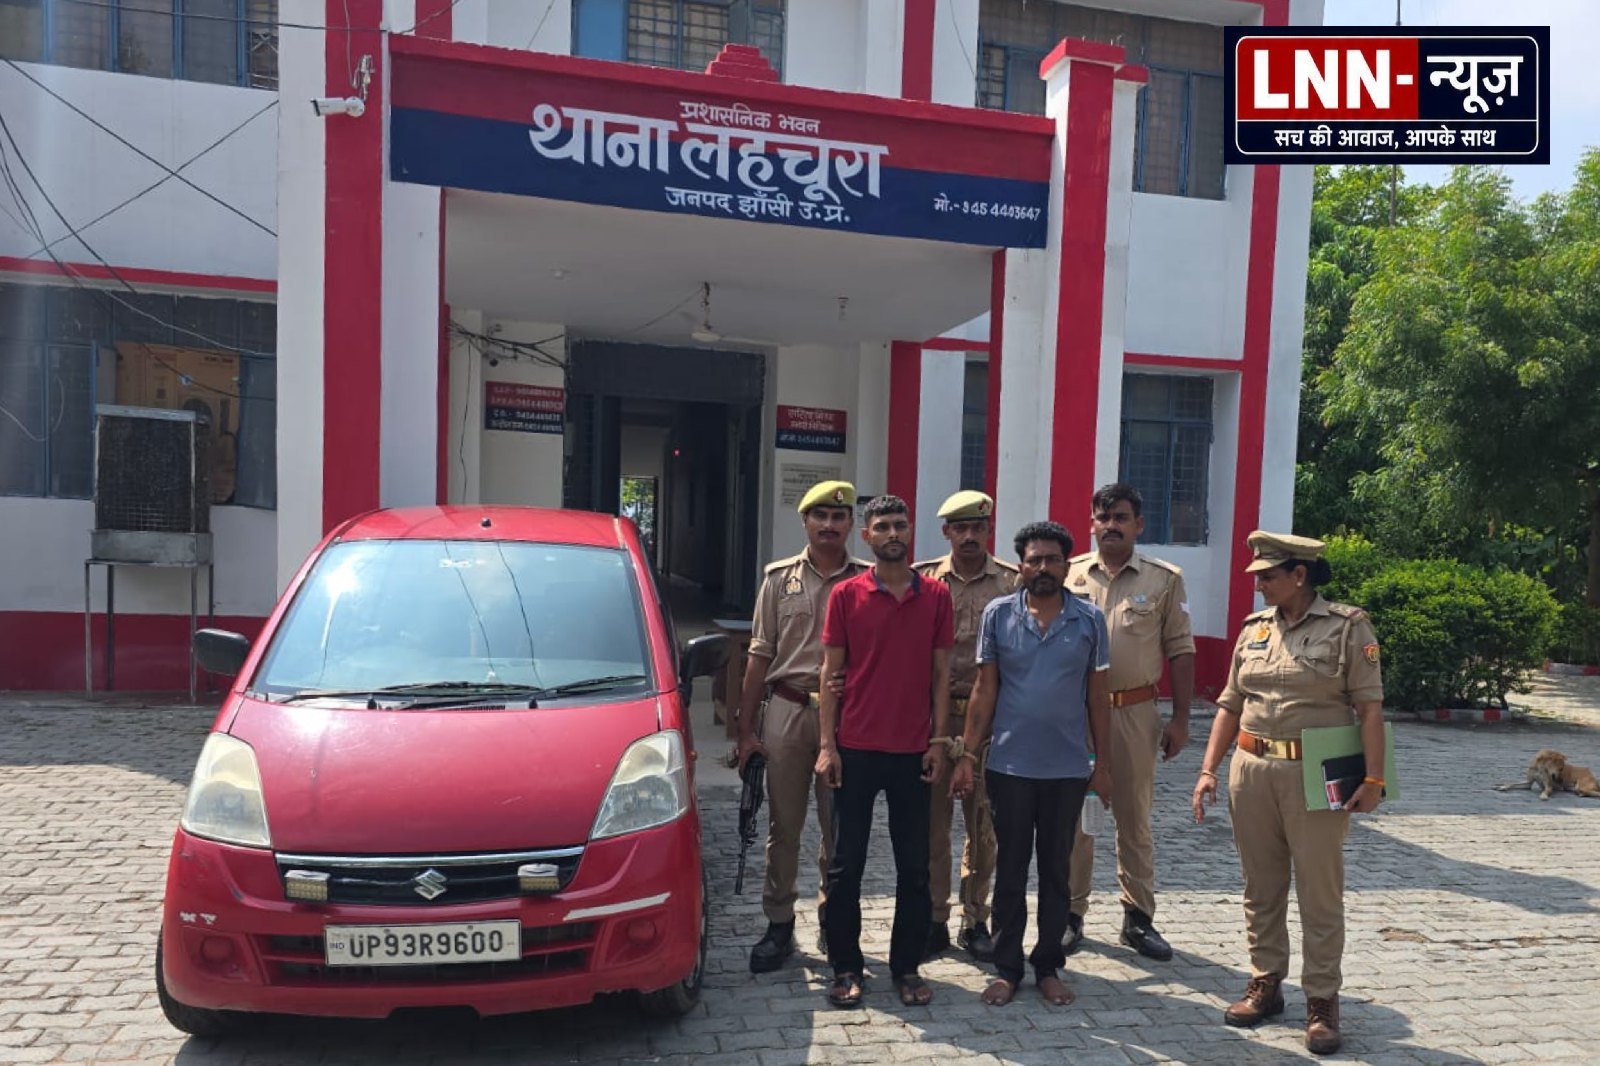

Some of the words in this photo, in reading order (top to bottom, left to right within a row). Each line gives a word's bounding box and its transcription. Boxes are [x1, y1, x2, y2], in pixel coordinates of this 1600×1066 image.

[680, 101, 772, 129] प्रशासनिक
[778, 113, 821, 135] भवन
[529, 103, 679, 174] थाना
[680, 121, 889, 205] लहचूरा
[664, 186, 733, 214] जनपद
[737, 190, 794, 219] झाँसी
[350, 930, 503, 958] UP93R9600
